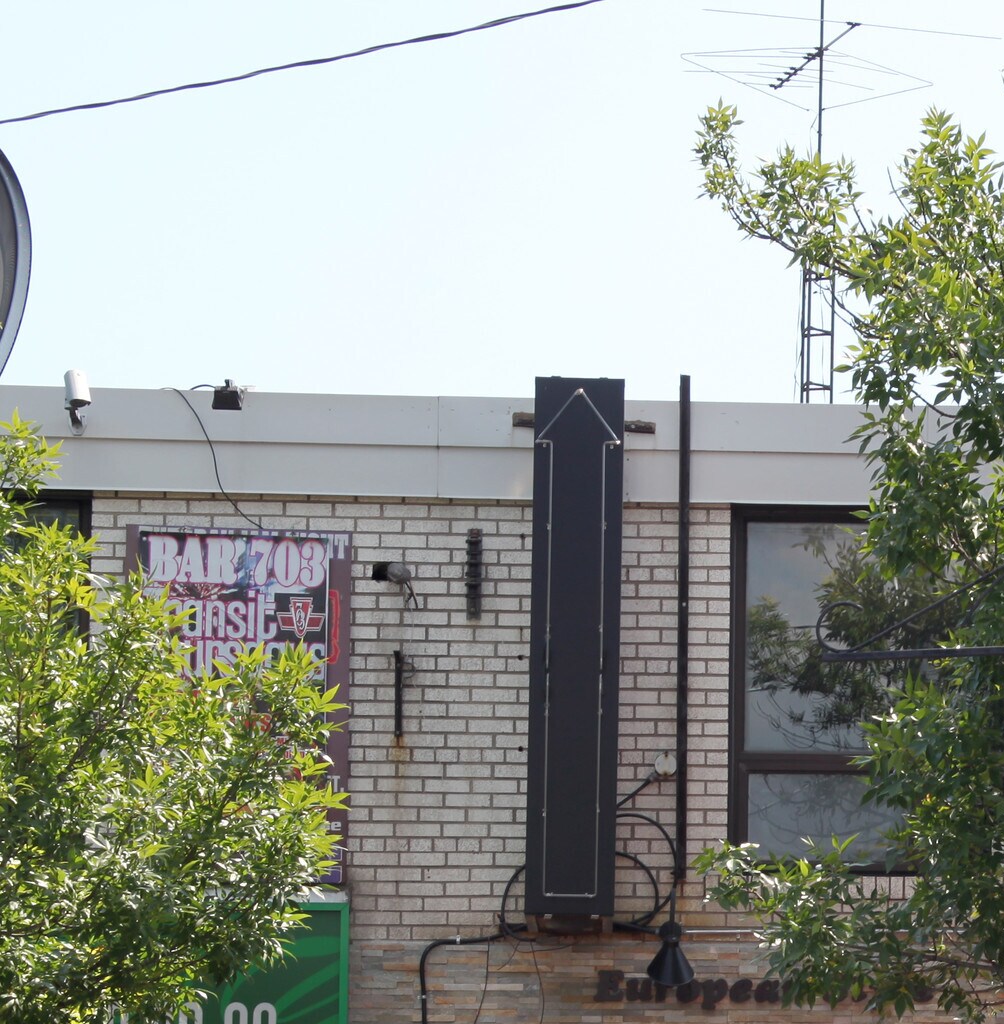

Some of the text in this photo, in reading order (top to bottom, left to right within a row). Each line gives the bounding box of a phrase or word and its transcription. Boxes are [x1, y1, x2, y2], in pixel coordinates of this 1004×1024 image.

[149, 536, 238, 585] BAR
[249, 537, 327, 587] 703
[145, 588, 277, 640] ansit
